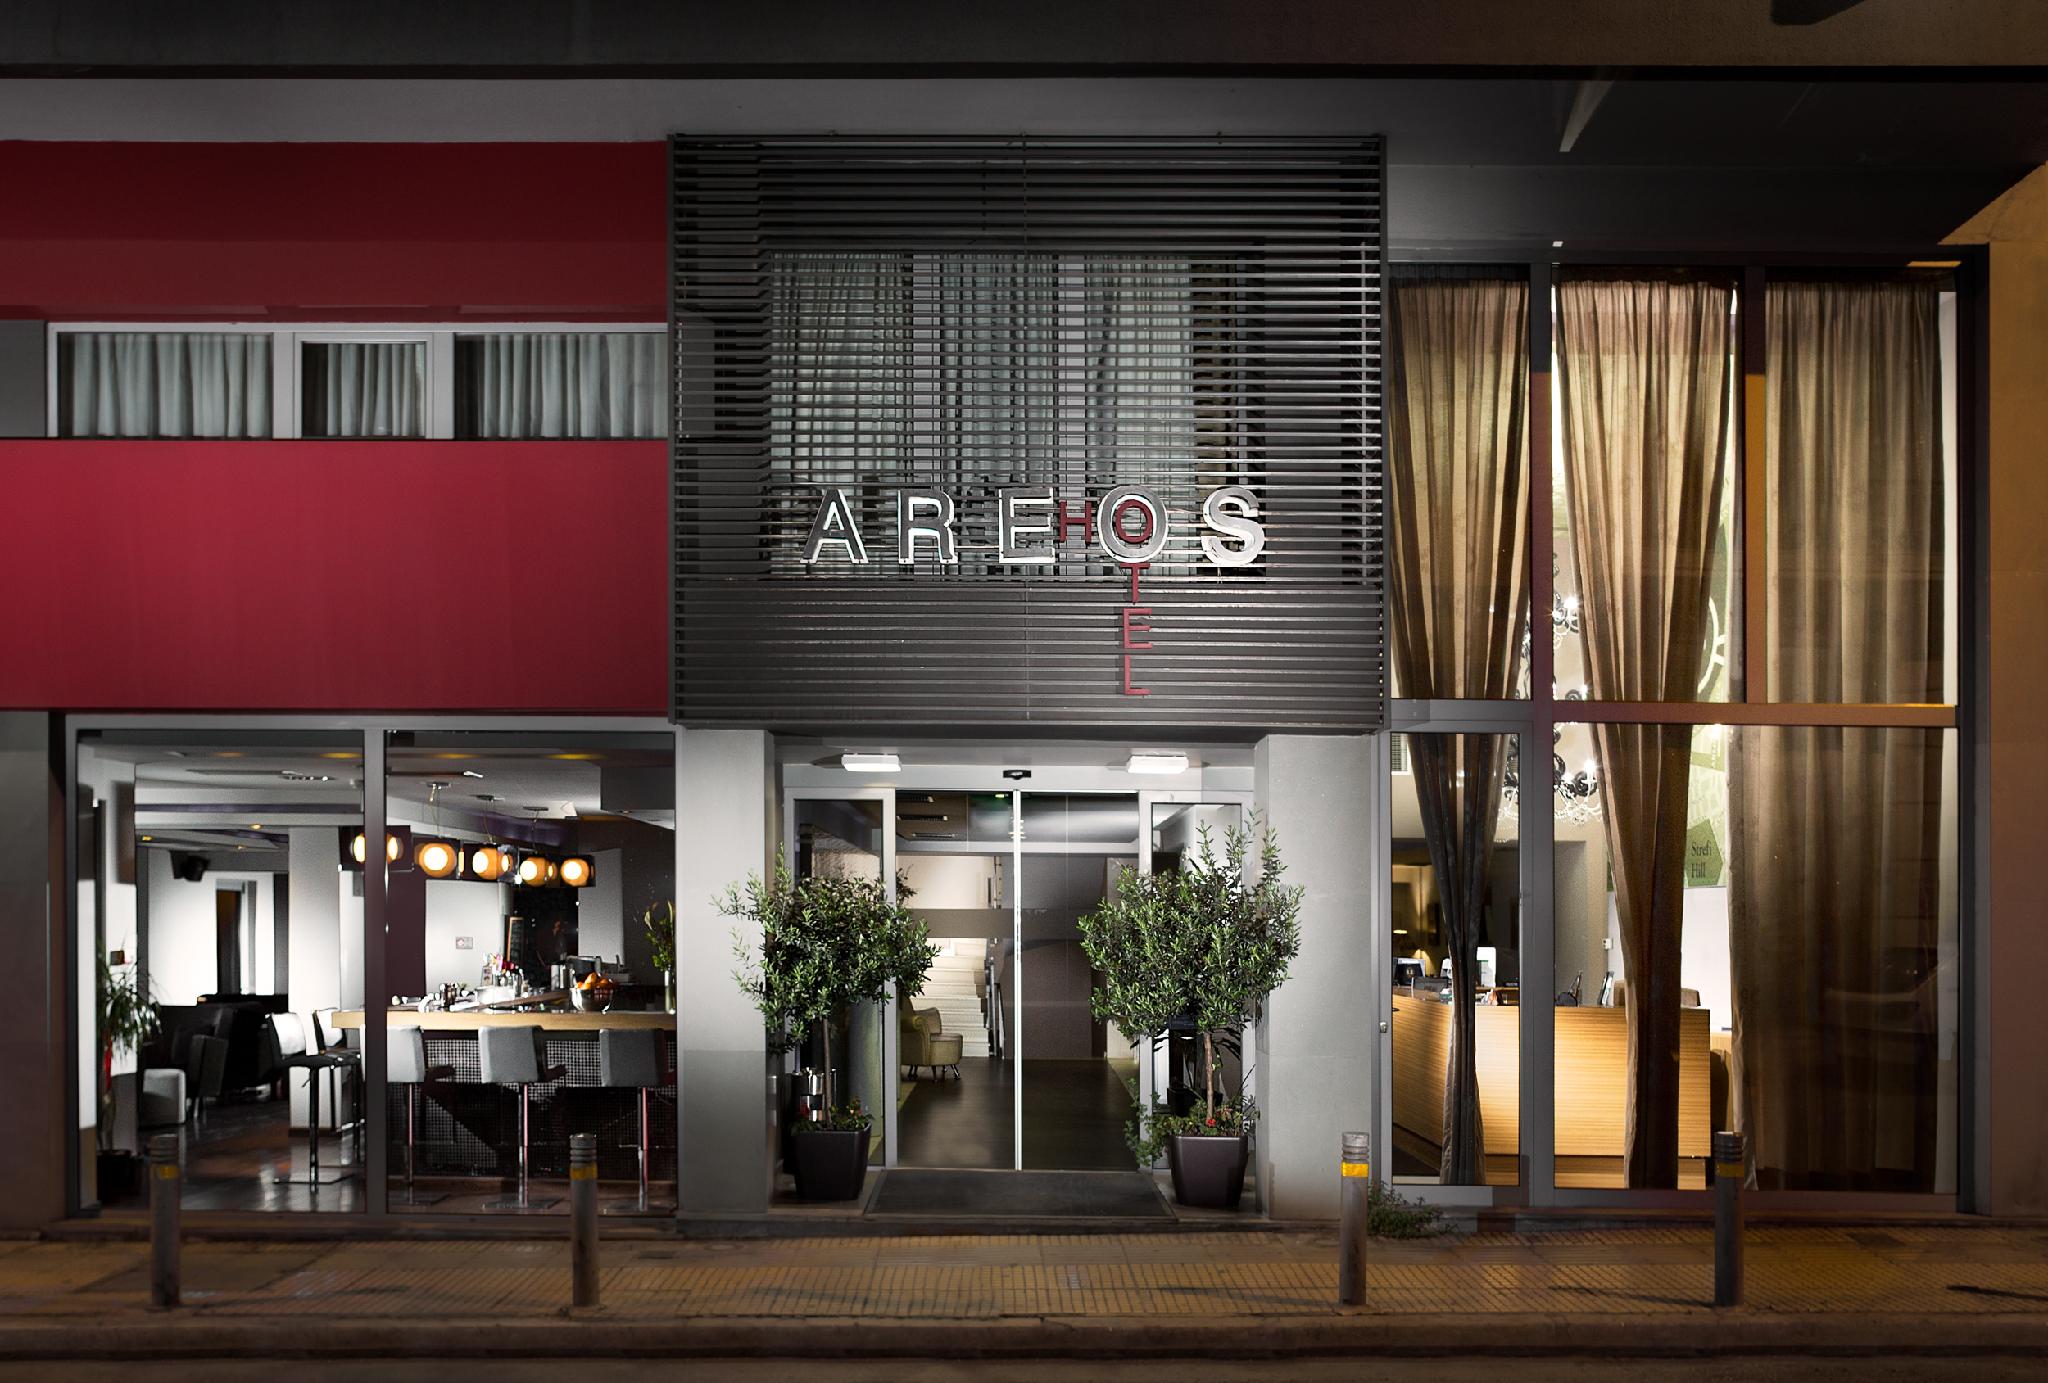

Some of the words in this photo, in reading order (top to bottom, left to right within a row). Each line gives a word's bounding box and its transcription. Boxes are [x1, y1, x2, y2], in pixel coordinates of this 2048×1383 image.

[800, 485, 1266, 565] AREOS
[1691, 840, 1712, 856] Strefi
[1691, 863, 1706, 878] Hill
